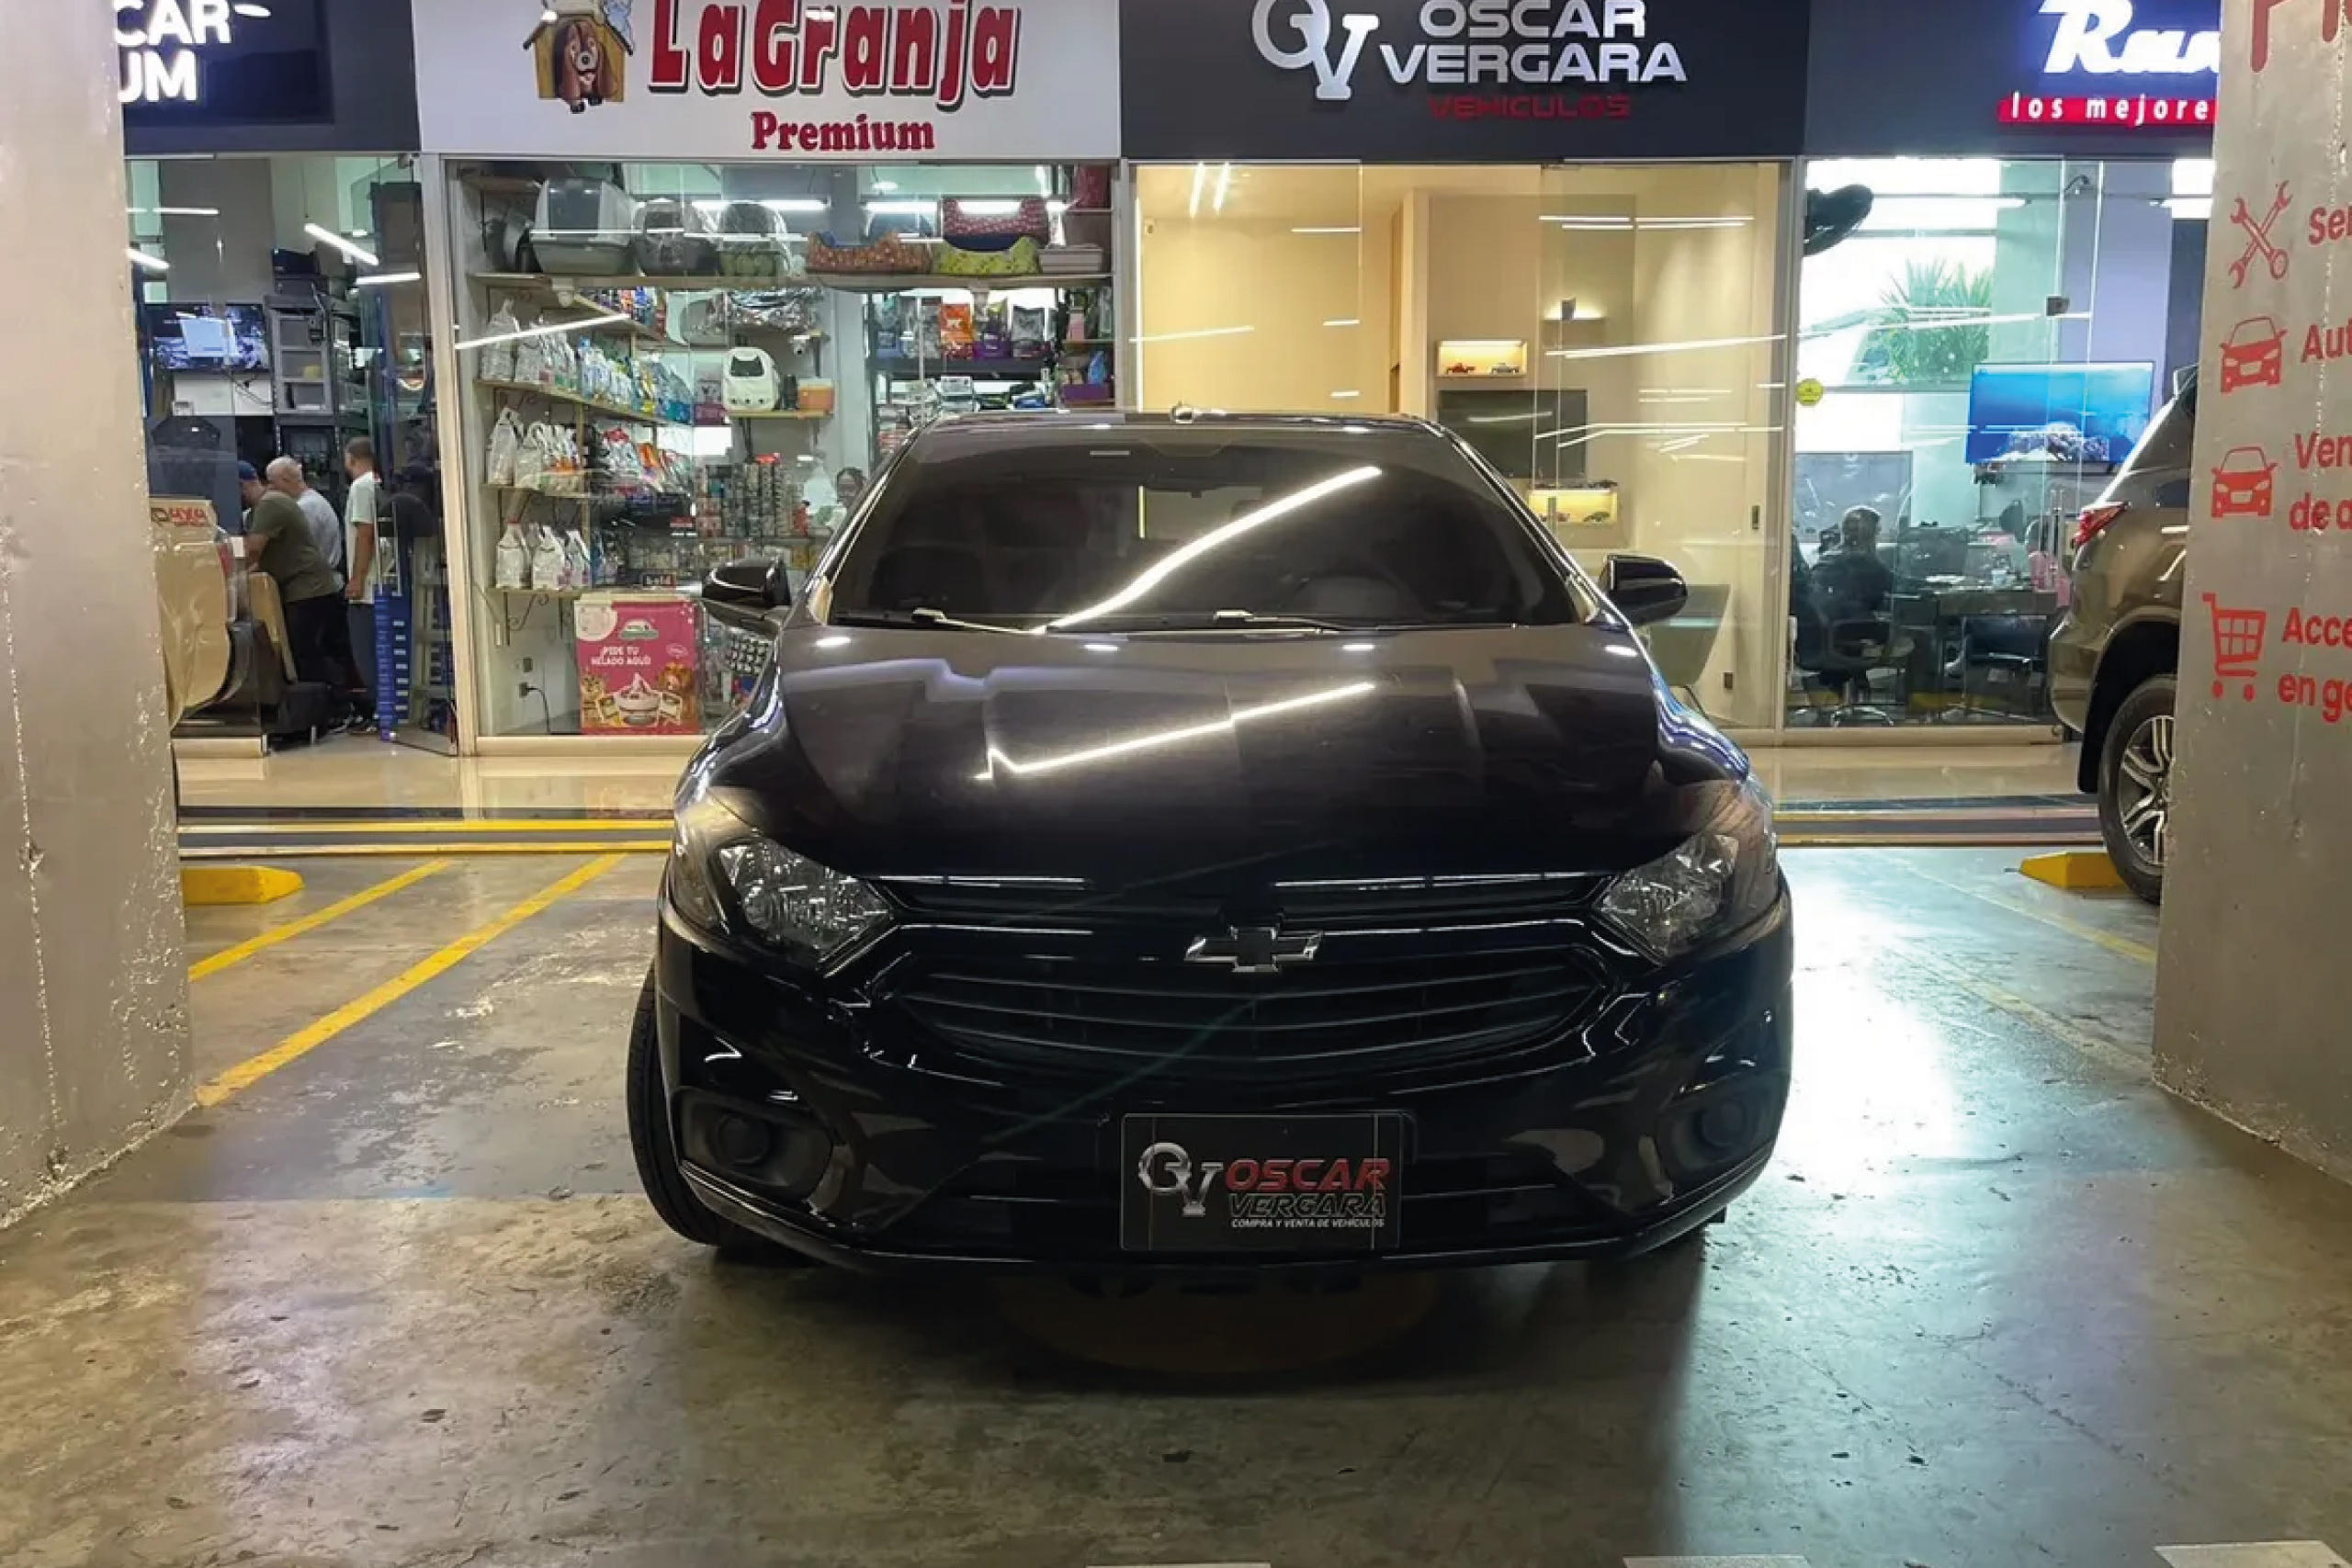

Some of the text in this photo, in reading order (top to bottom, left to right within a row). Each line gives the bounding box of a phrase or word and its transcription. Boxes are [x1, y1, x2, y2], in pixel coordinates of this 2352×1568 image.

[1419, 0, 1647, 39] OSCAR
[1379, 42, 1689, 84] VERGARA
[2011, 90, 2064, 118] los
[751, 111, 934, 151] Premium
[2289, 491, 2331, 530] de
[2277, 673, 2312, 705] en
[1224, 1157, 1391, 1191] OSCAR
[1228, 1192, 1387, 1218] VERGARA
[1231, 1218, 1272, 1228] COMPRA
[1275, 1218, 1282, 1228] Y
[1284, 1218, 1316, 1228] VENTA
[1317, 1218, 1329, 1228] DE
